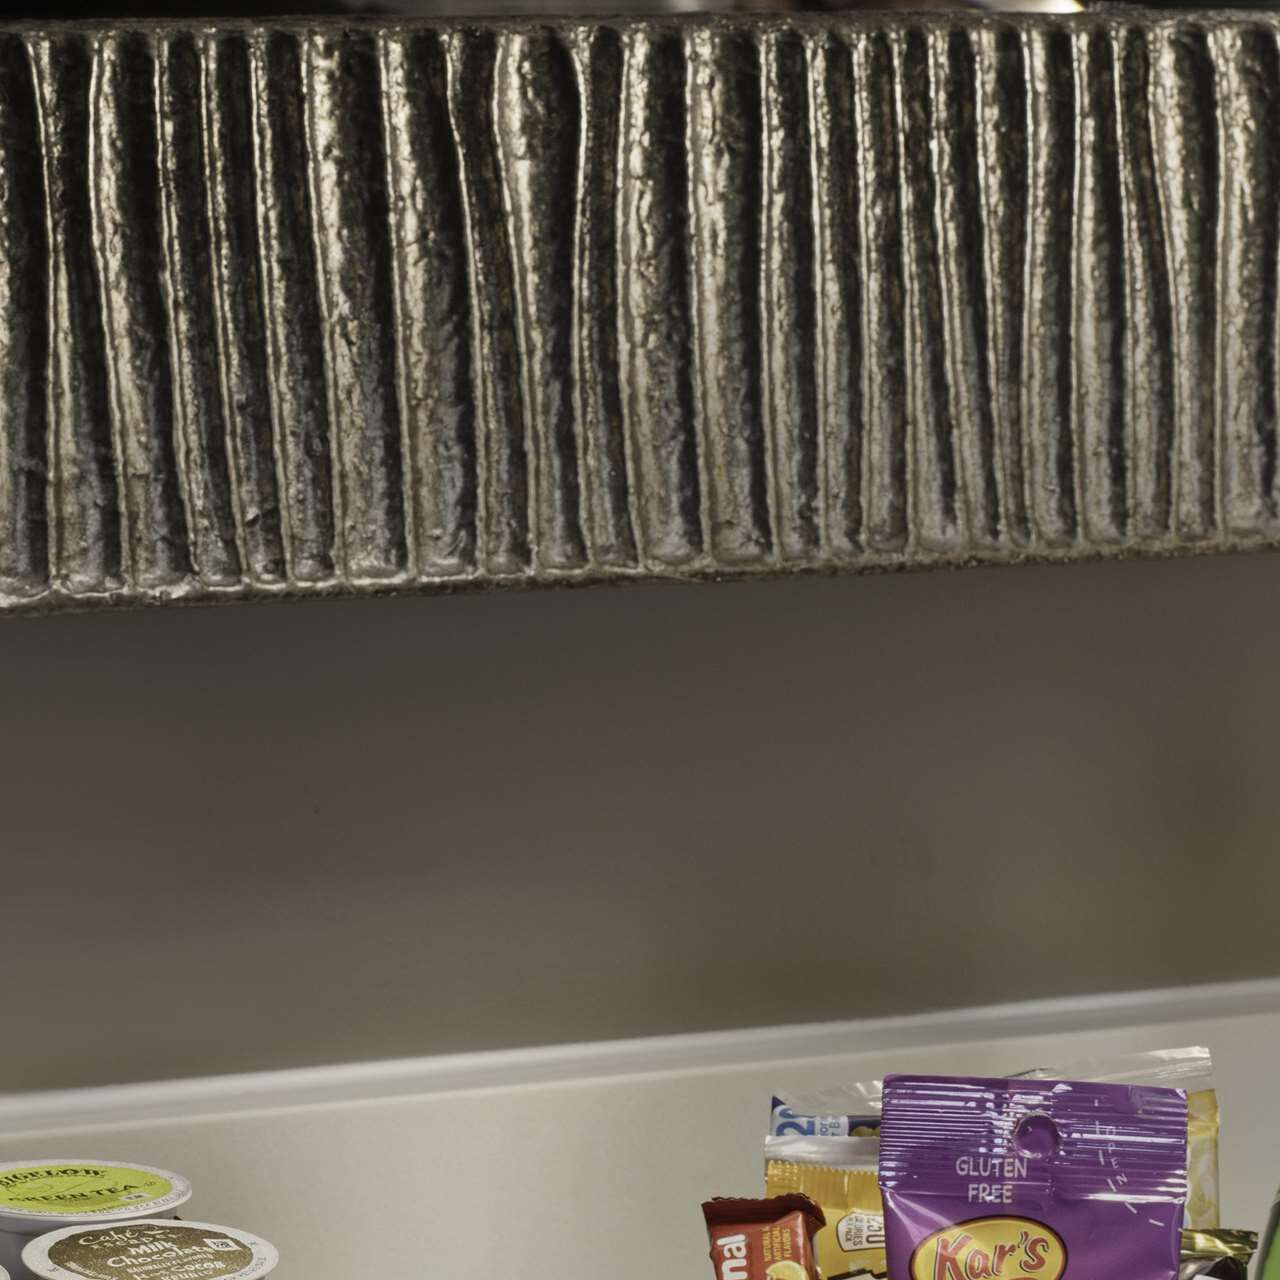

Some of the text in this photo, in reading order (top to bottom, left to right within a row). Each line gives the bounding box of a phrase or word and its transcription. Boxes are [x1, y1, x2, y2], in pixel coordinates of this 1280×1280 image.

[956, 1156, 1028, 1178] GLUTEN
[90, 1184, 139, 1198] TEA
[968, 1183, 1013, 1203] FREE
[128, 1241, 176, 1255] Milk
[762, 1232, 772, 1261] NATURAL
[773, 1226, 782, 1261] ARTIFICIAL
[783, 1228, 792, 1258] FLAVORS
